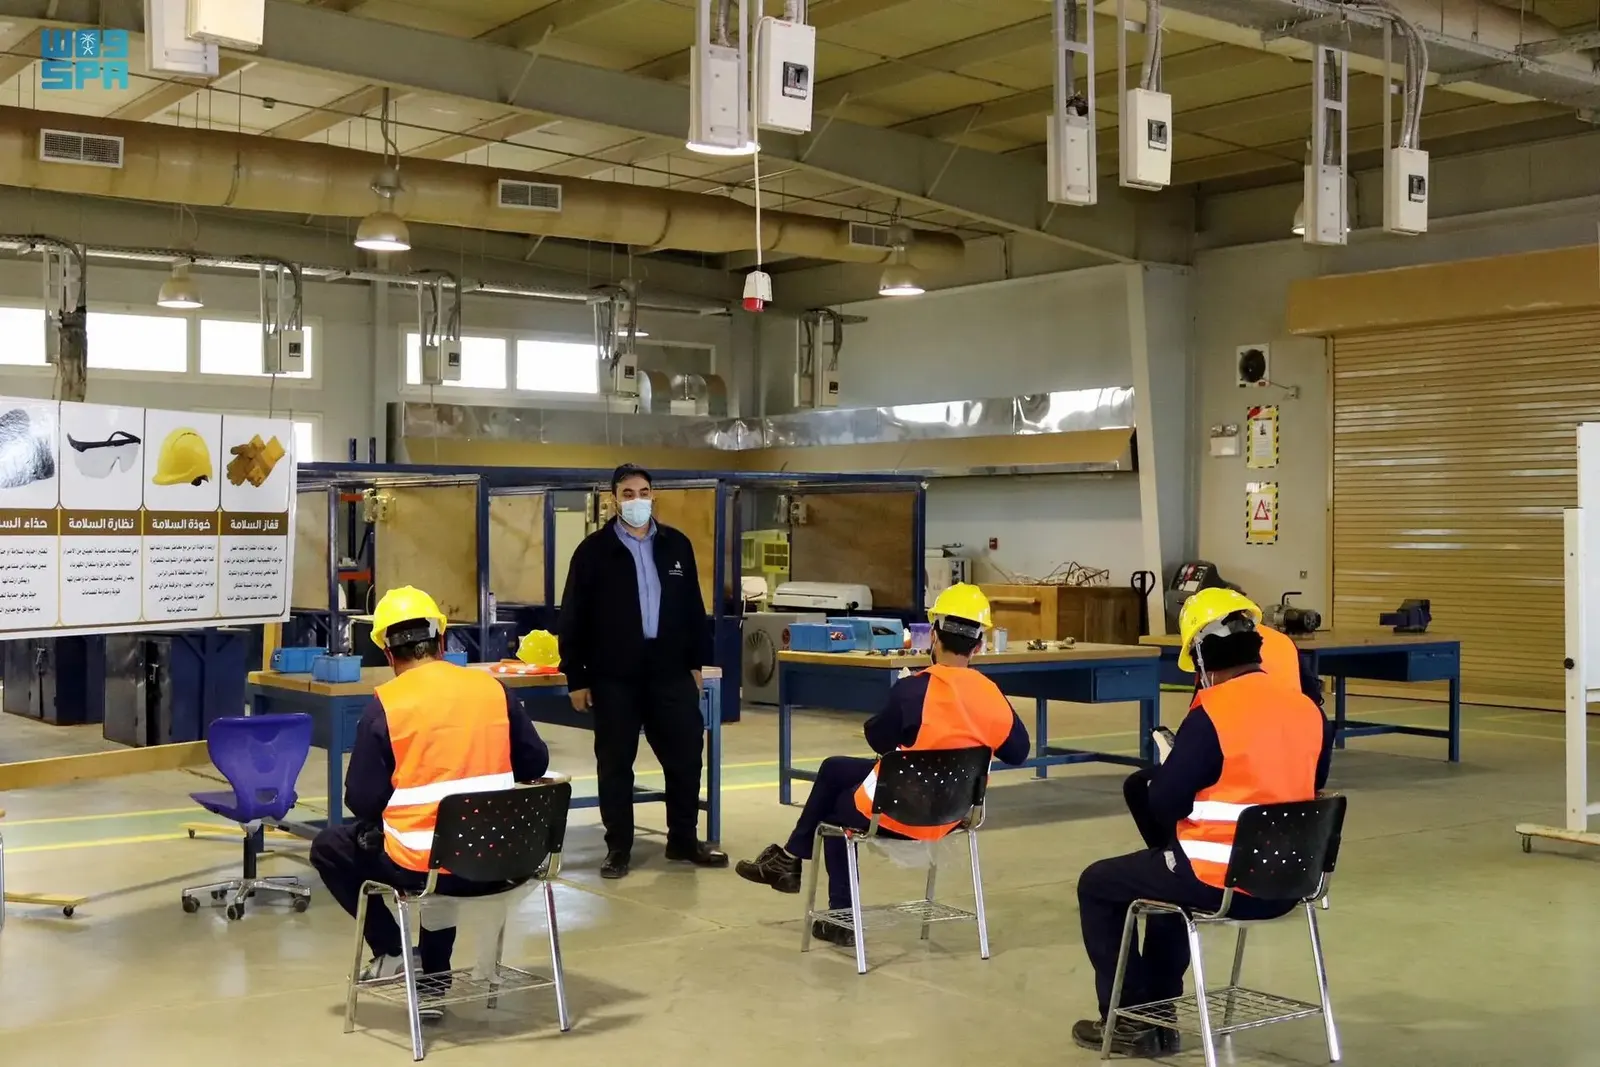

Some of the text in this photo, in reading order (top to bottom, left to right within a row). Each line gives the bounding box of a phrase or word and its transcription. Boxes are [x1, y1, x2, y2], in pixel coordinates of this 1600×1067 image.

[0, 517, 48, 529] حذاء الس
[68, 518, 134, 531] نظارة السلامة
[152, 519, 211, 531] خوذة السلامة
[230, 519, 279, 531] قفاز السلامة
